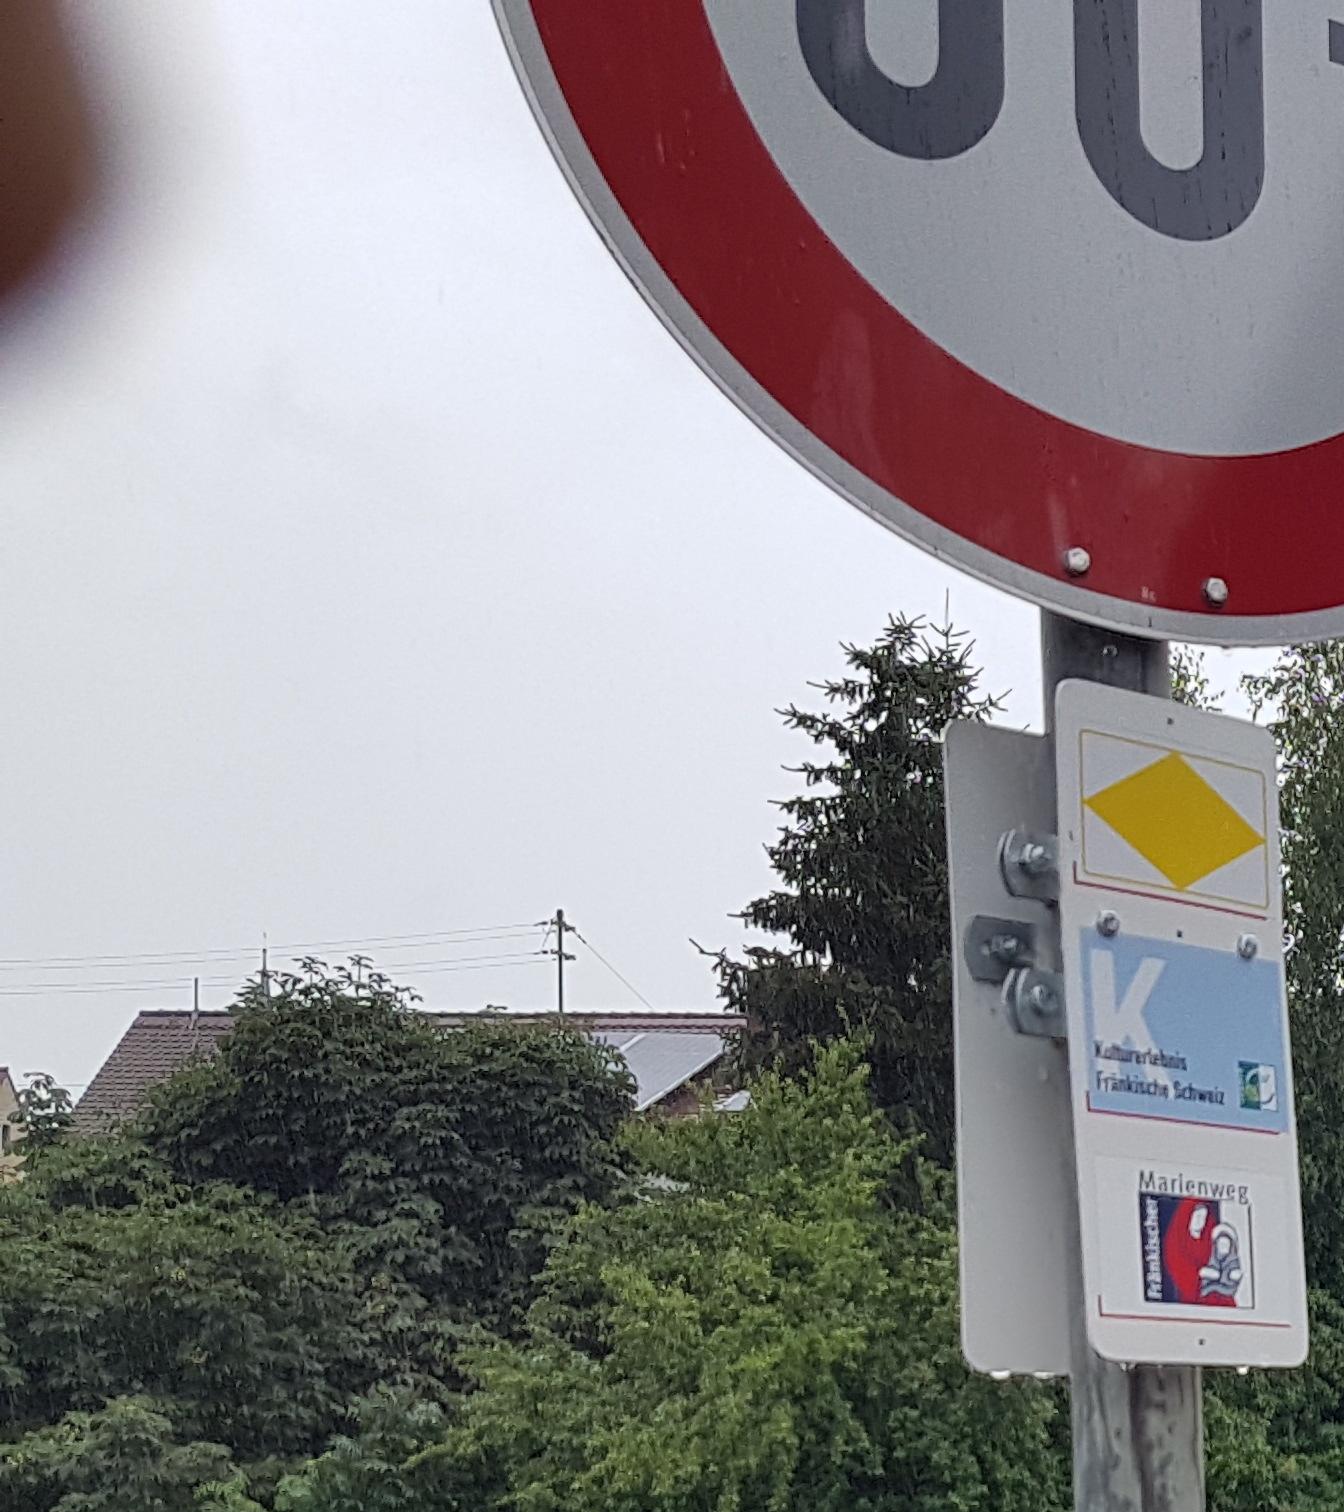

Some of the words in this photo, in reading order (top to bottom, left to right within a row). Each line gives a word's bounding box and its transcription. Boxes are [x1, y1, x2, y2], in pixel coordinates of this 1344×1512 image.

[1091, 948, 1174, 1099] K
[1096, 1071, 1169, 1099] Fränkische
[1174, 1080, 1225, 1105] Schweiz
[1139, 1170, 1249, 1205] Marienweg
